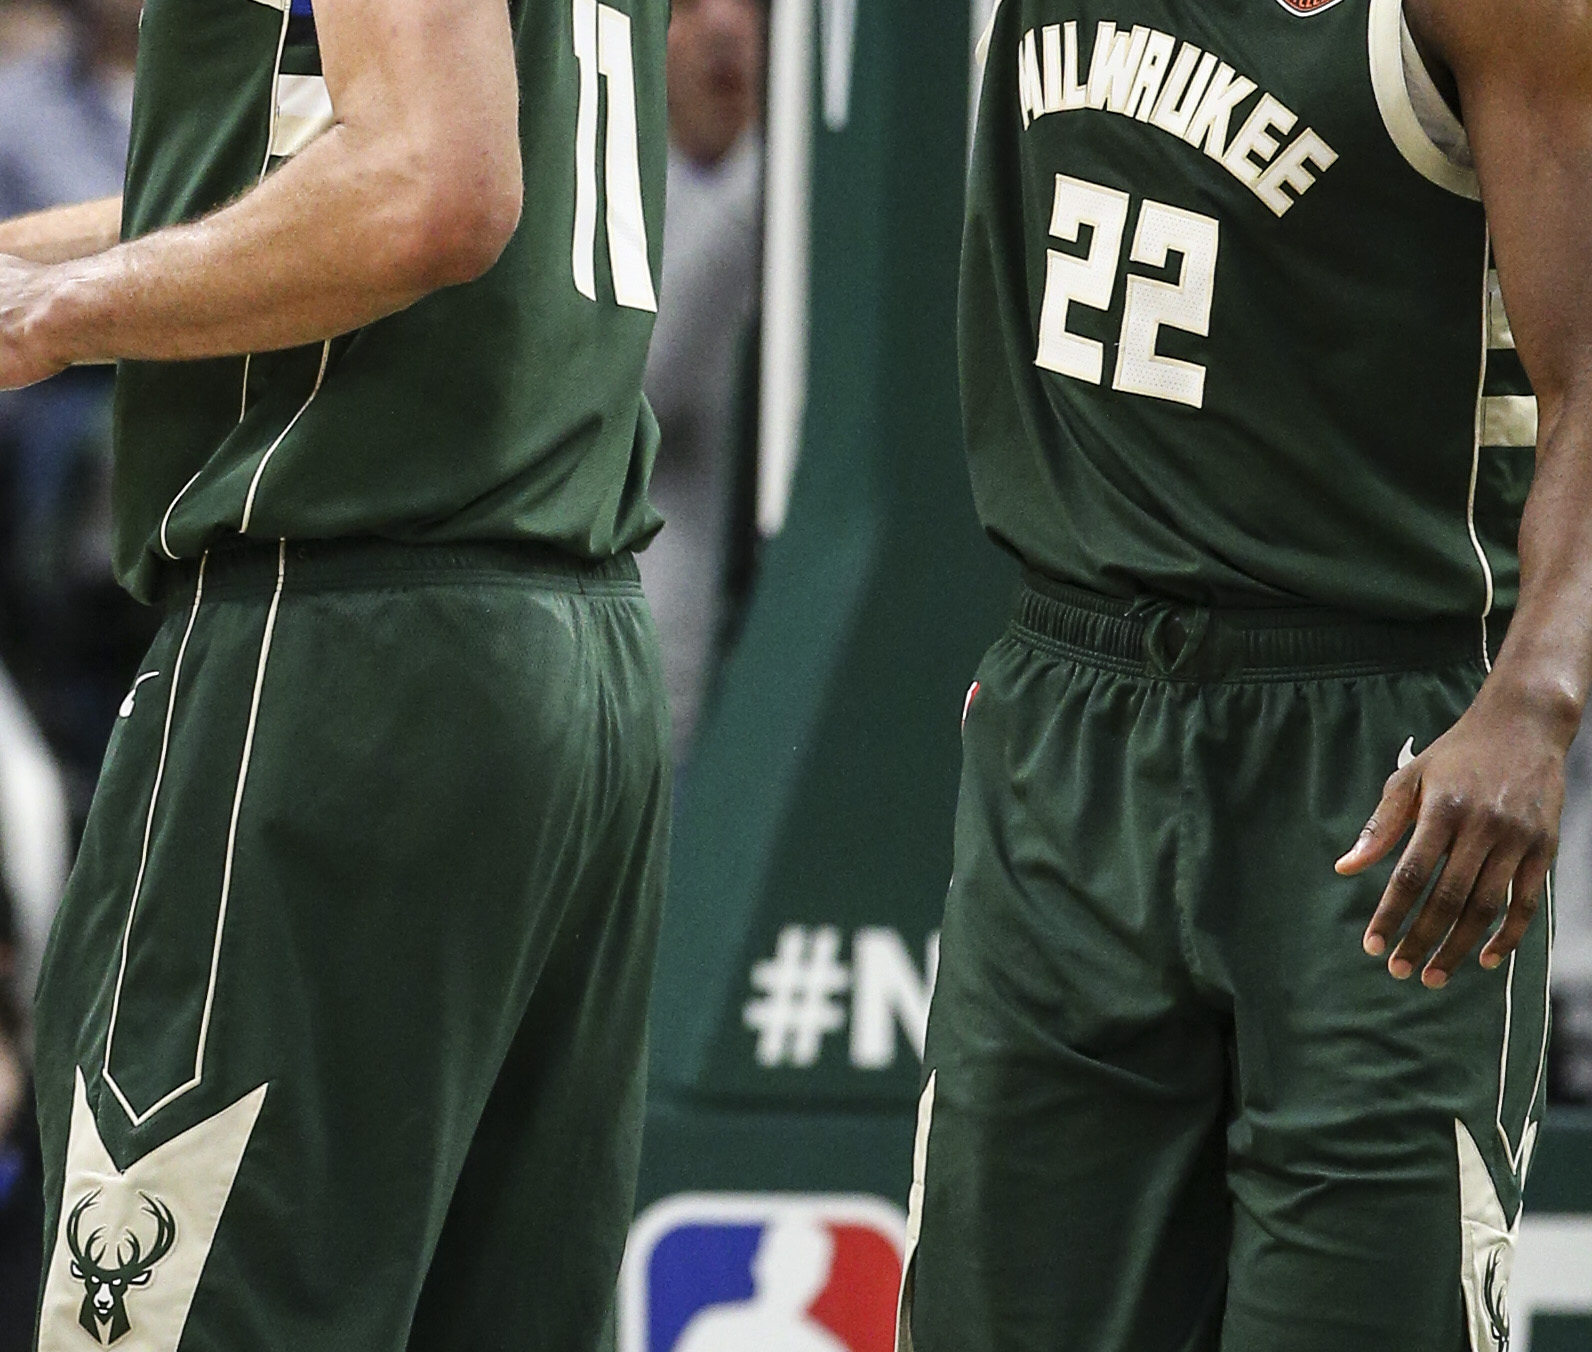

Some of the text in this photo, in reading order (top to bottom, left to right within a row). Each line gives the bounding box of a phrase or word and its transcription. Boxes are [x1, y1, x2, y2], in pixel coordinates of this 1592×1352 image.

[1018, 20, 1339, 218] MILWAUKEE
[1035, 173, 1219, 408] 22
[741, 920, 941, 1069] #N
